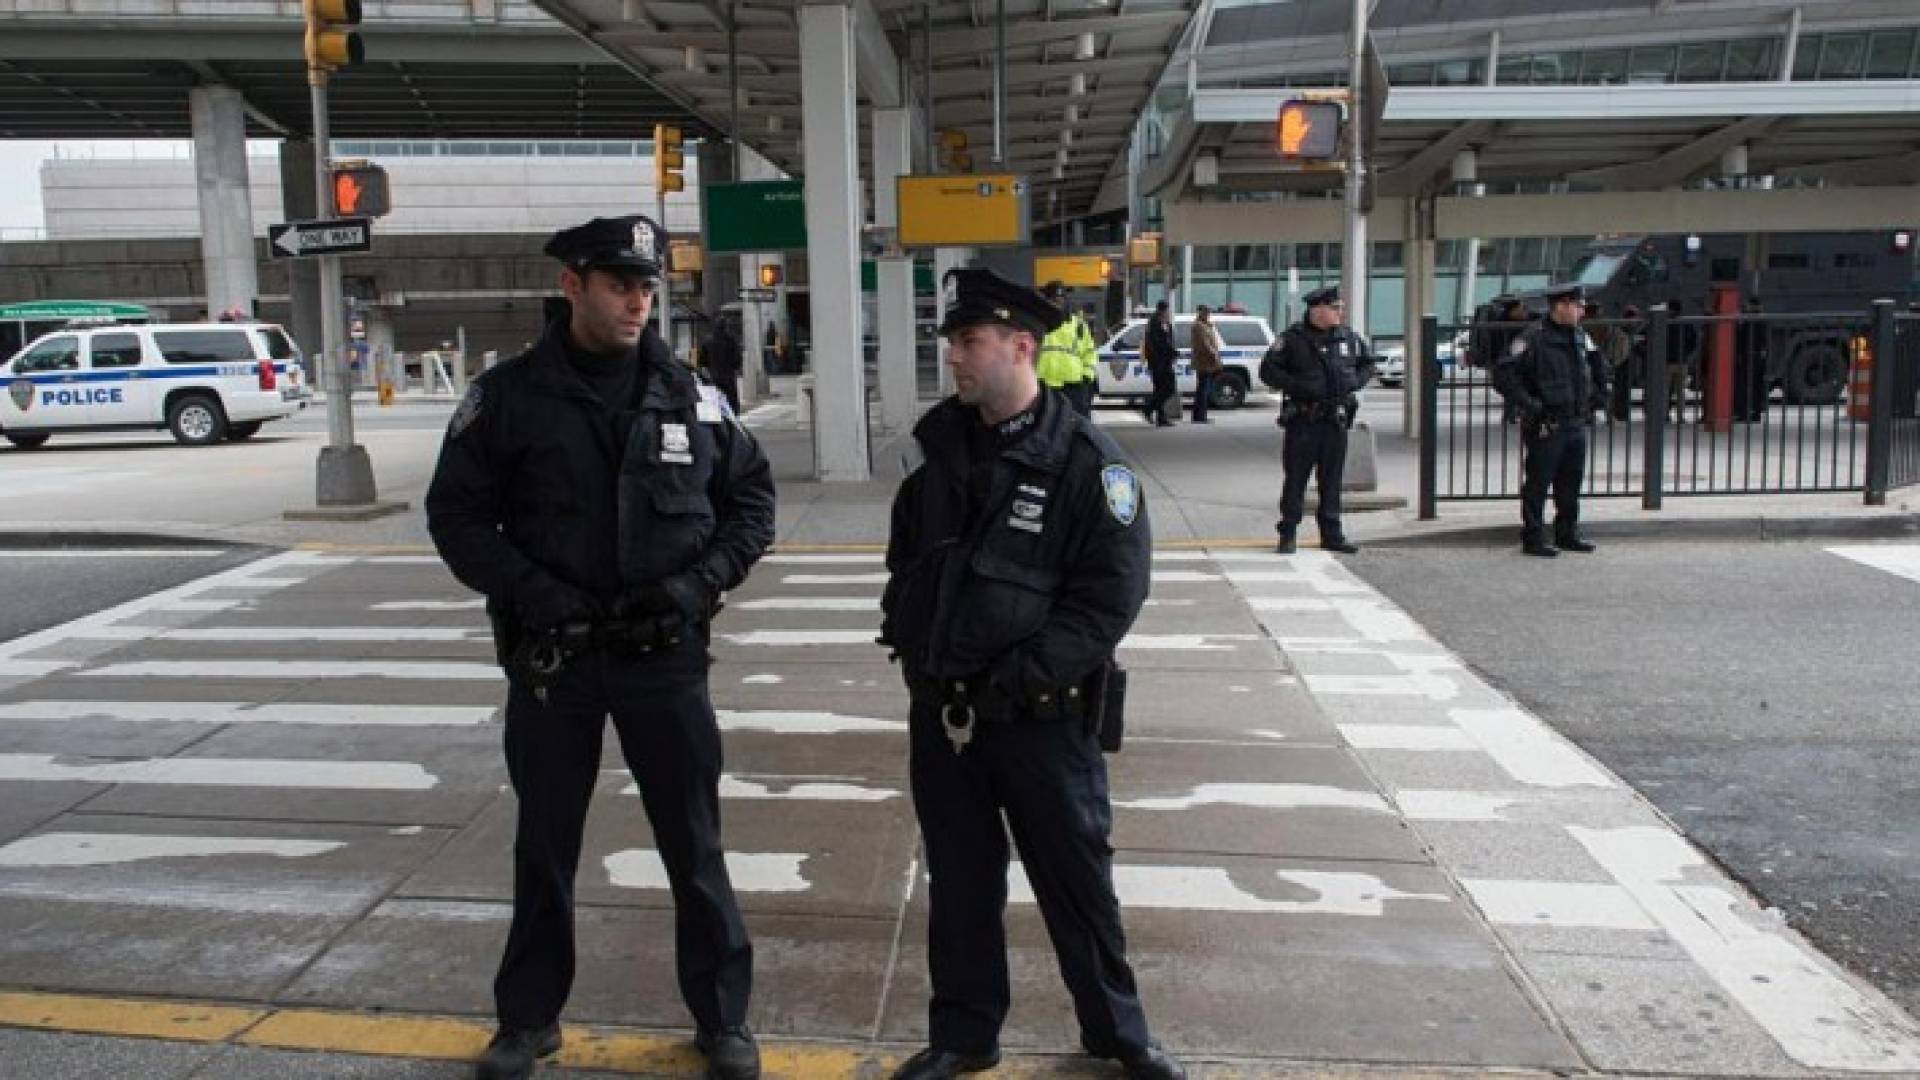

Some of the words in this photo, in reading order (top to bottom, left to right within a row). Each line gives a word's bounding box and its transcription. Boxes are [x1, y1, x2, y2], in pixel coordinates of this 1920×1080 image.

[301, 230, 324, 245] ONE
[331, 229, 359, 243] WAY
[42, 388, 124, 406] POLICE
